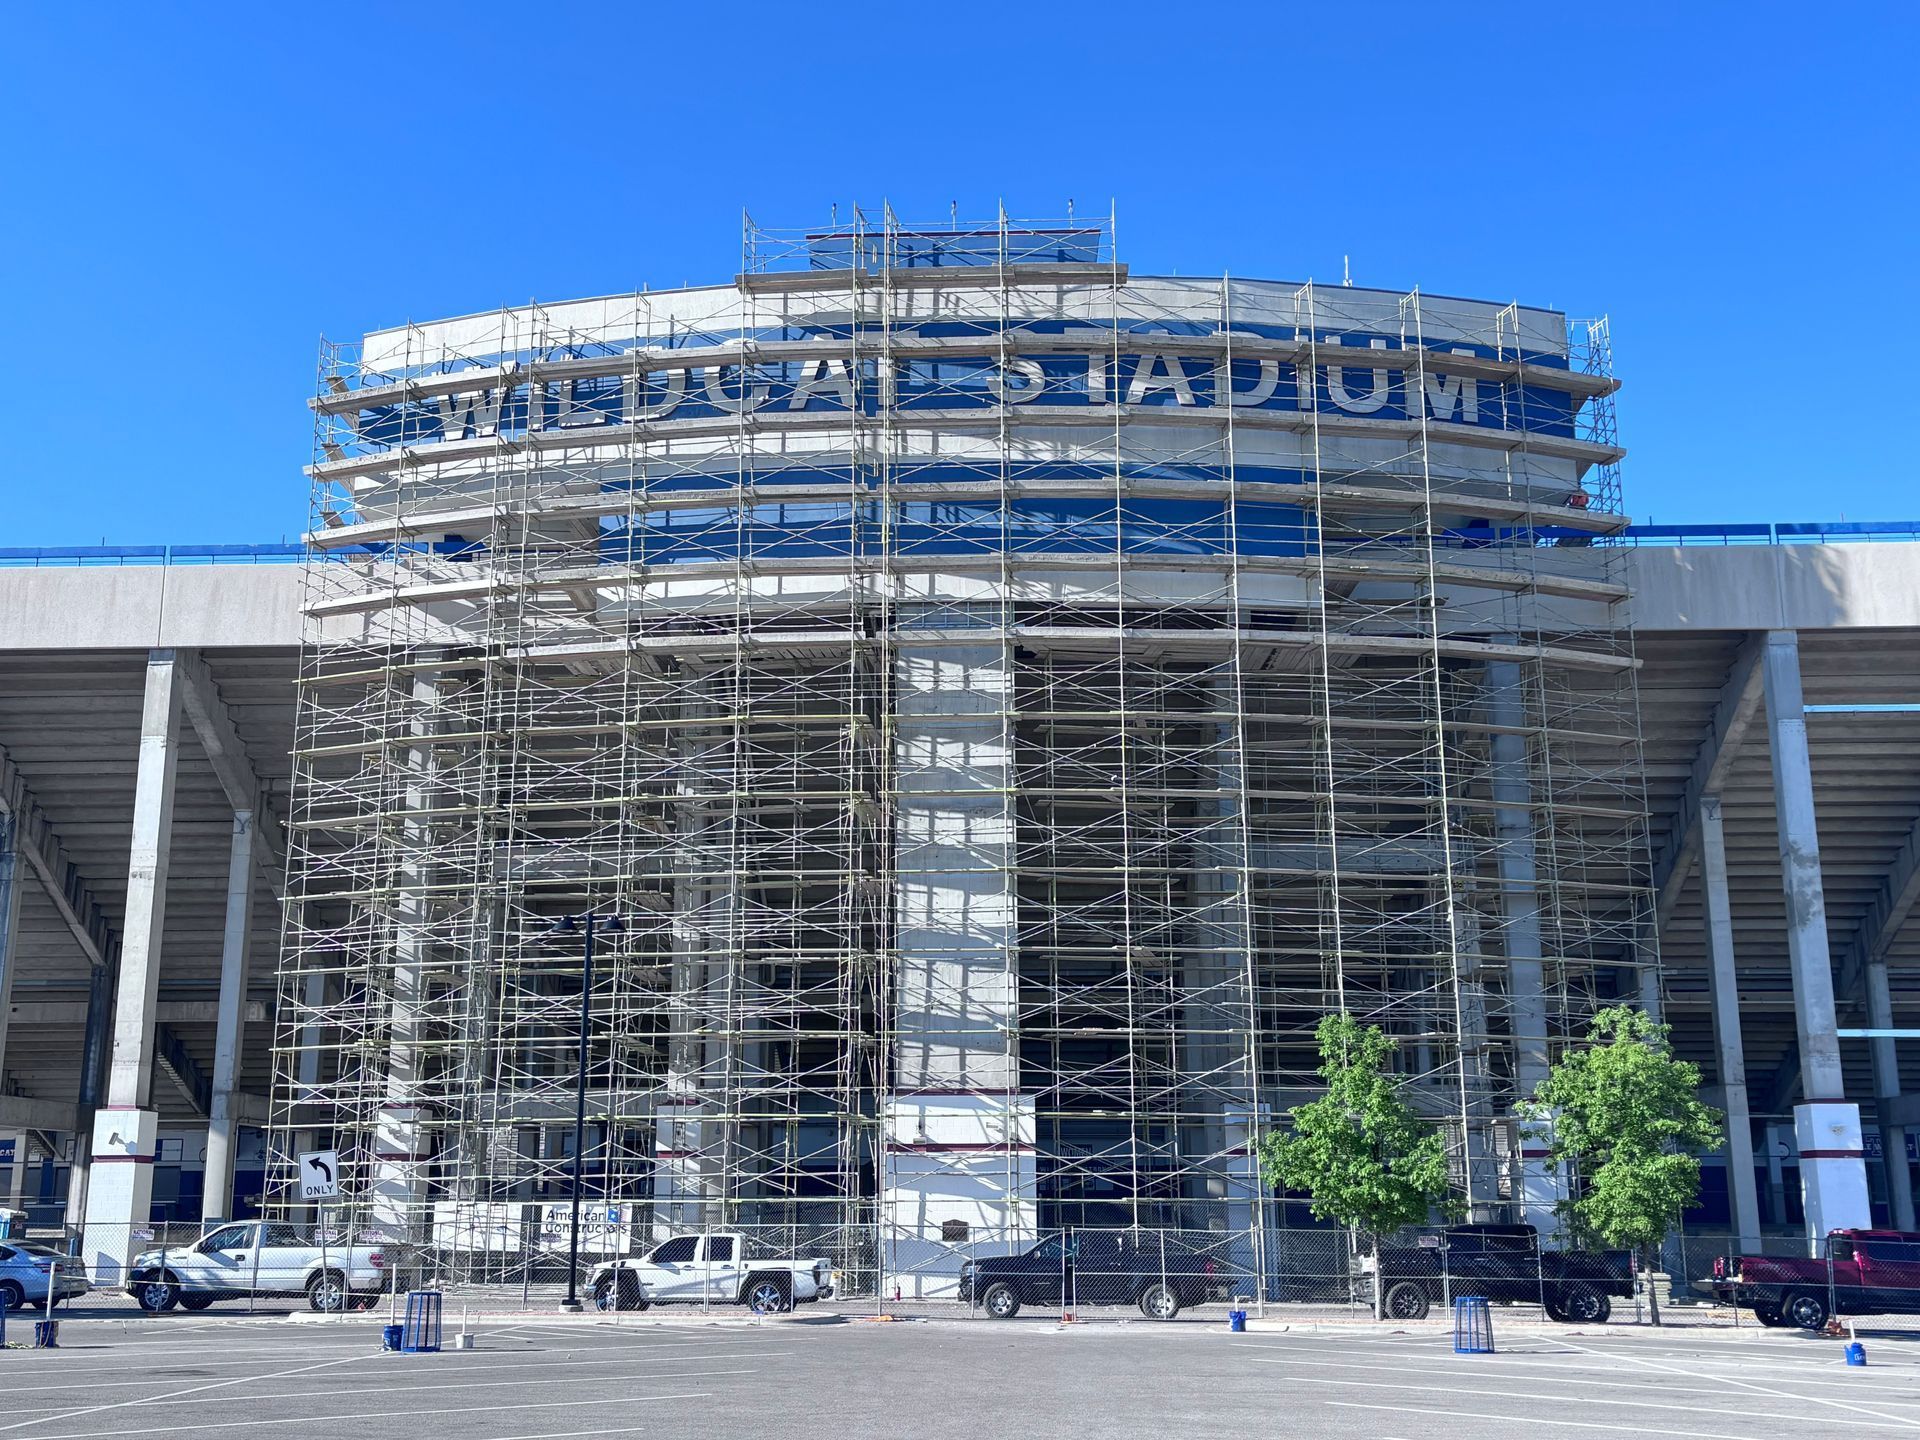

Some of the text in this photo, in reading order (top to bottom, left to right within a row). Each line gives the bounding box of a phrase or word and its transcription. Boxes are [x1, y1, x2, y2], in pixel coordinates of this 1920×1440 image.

[431, 327, 1478, 440] WILDCAT STADIUM
[306, 1184, 333, 1196] ONLY
[546, 1210, 605, 1221] Ameican
[545, 1224, 627, 1234] Conrucos
